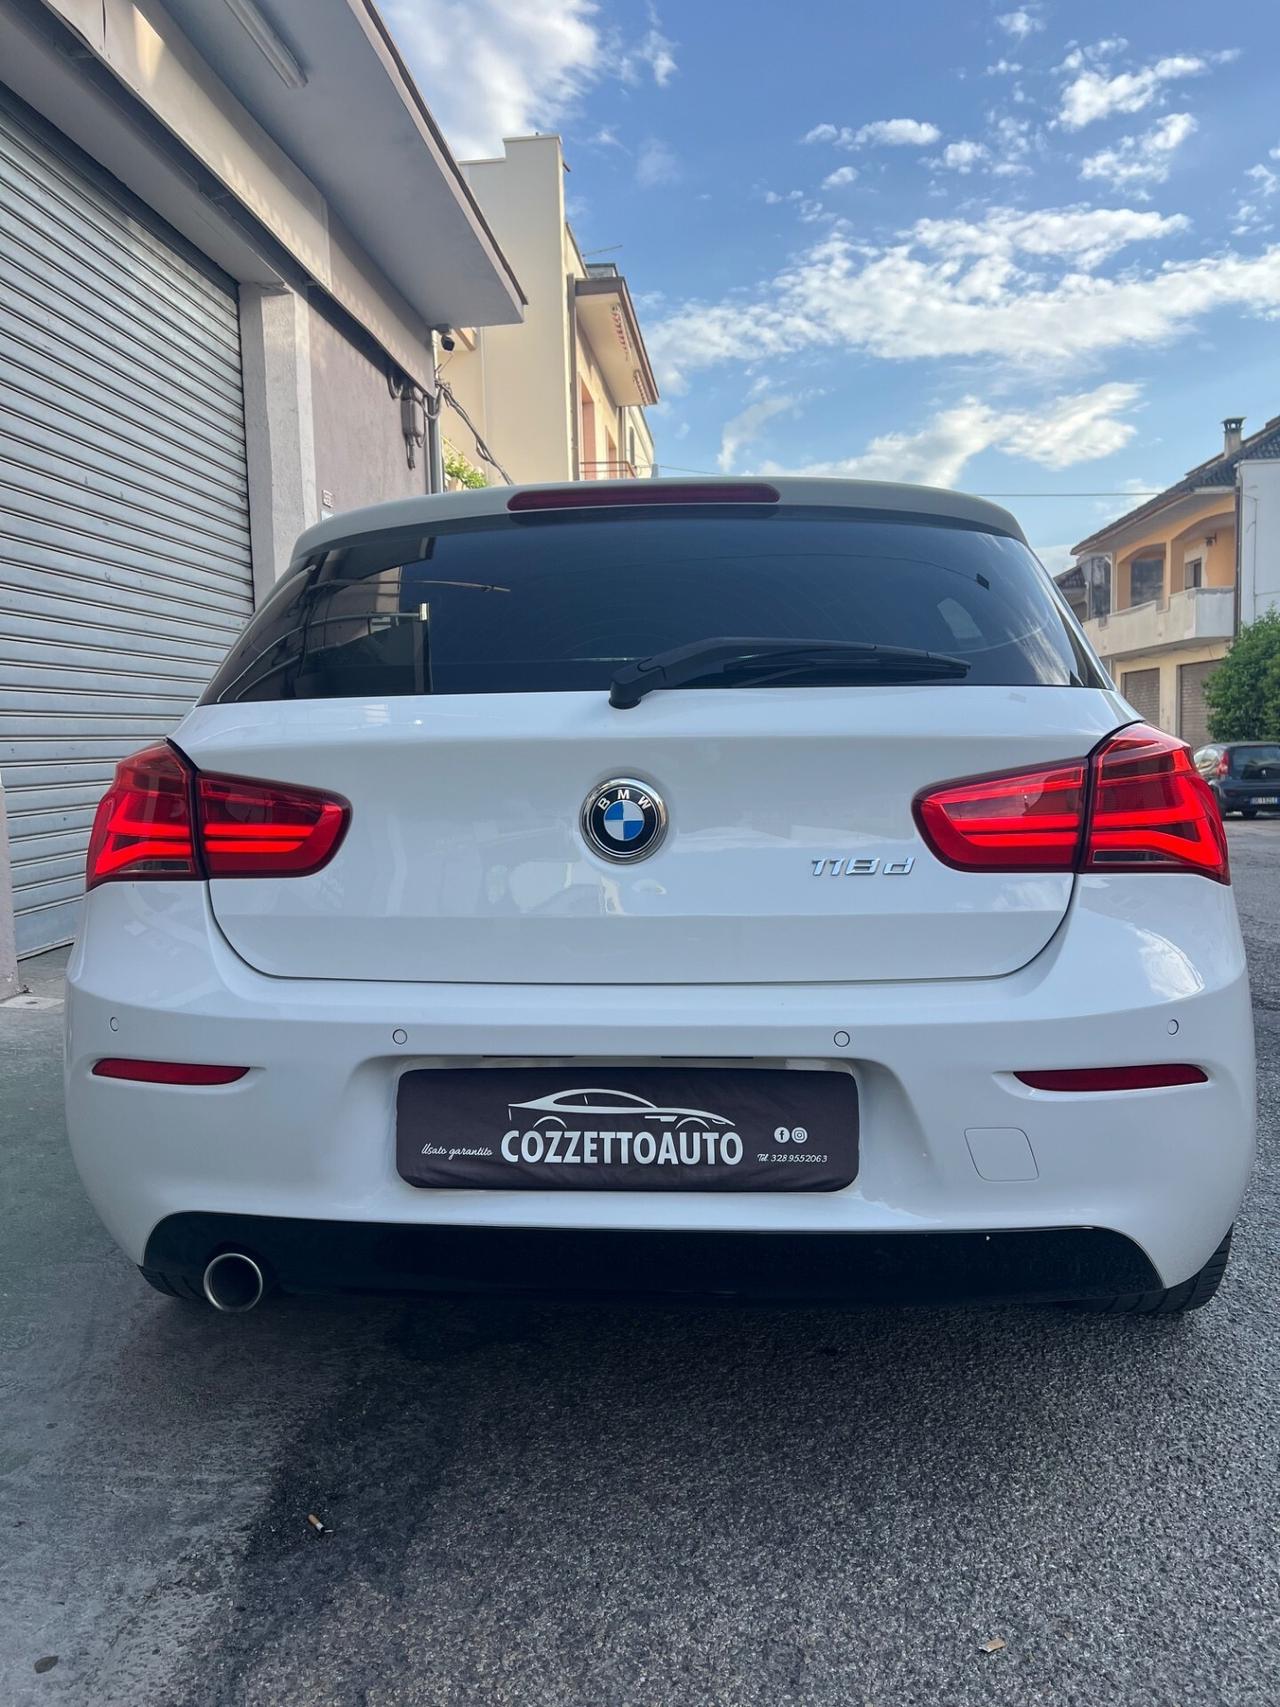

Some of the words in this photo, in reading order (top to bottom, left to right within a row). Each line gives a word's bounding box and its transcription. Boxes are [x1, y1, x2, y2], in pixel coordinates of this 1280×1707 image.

[598, 789, 652, 811] BMW
[421, 1142, 447, 1155] Usato
[448, 1146, 493, 1161] garantito
[500, 1130, 743, 1165] COZZETTOAUTO
